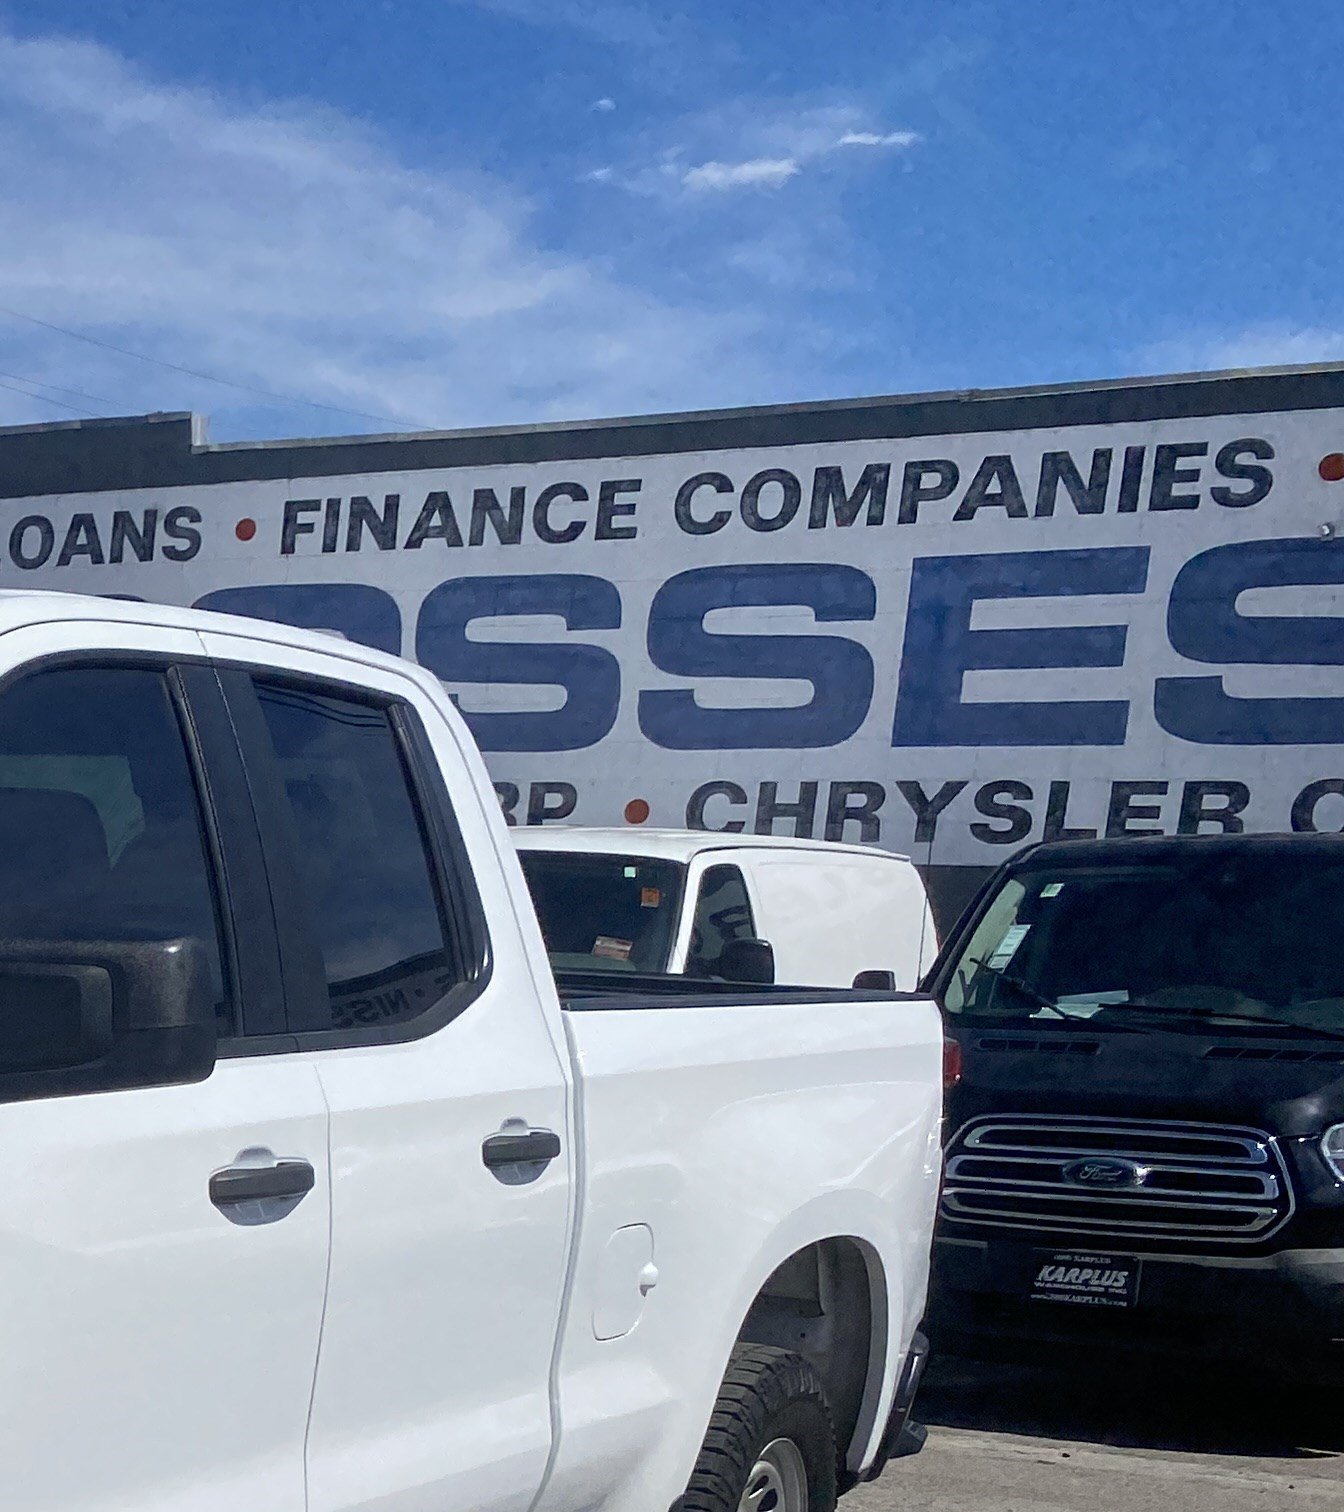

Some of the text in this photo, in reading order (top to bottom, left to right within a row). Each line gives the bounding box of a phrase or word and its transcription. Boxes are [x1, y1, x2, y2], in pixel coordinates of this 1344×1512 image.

[279, 477, 643, 555] FINANCE
[673, 438, 1275, 536] COMPANIES
[685, 779, 1251, 845] CHRYSLER
[1036, 1265, 1129, 1288] KARPLUS
